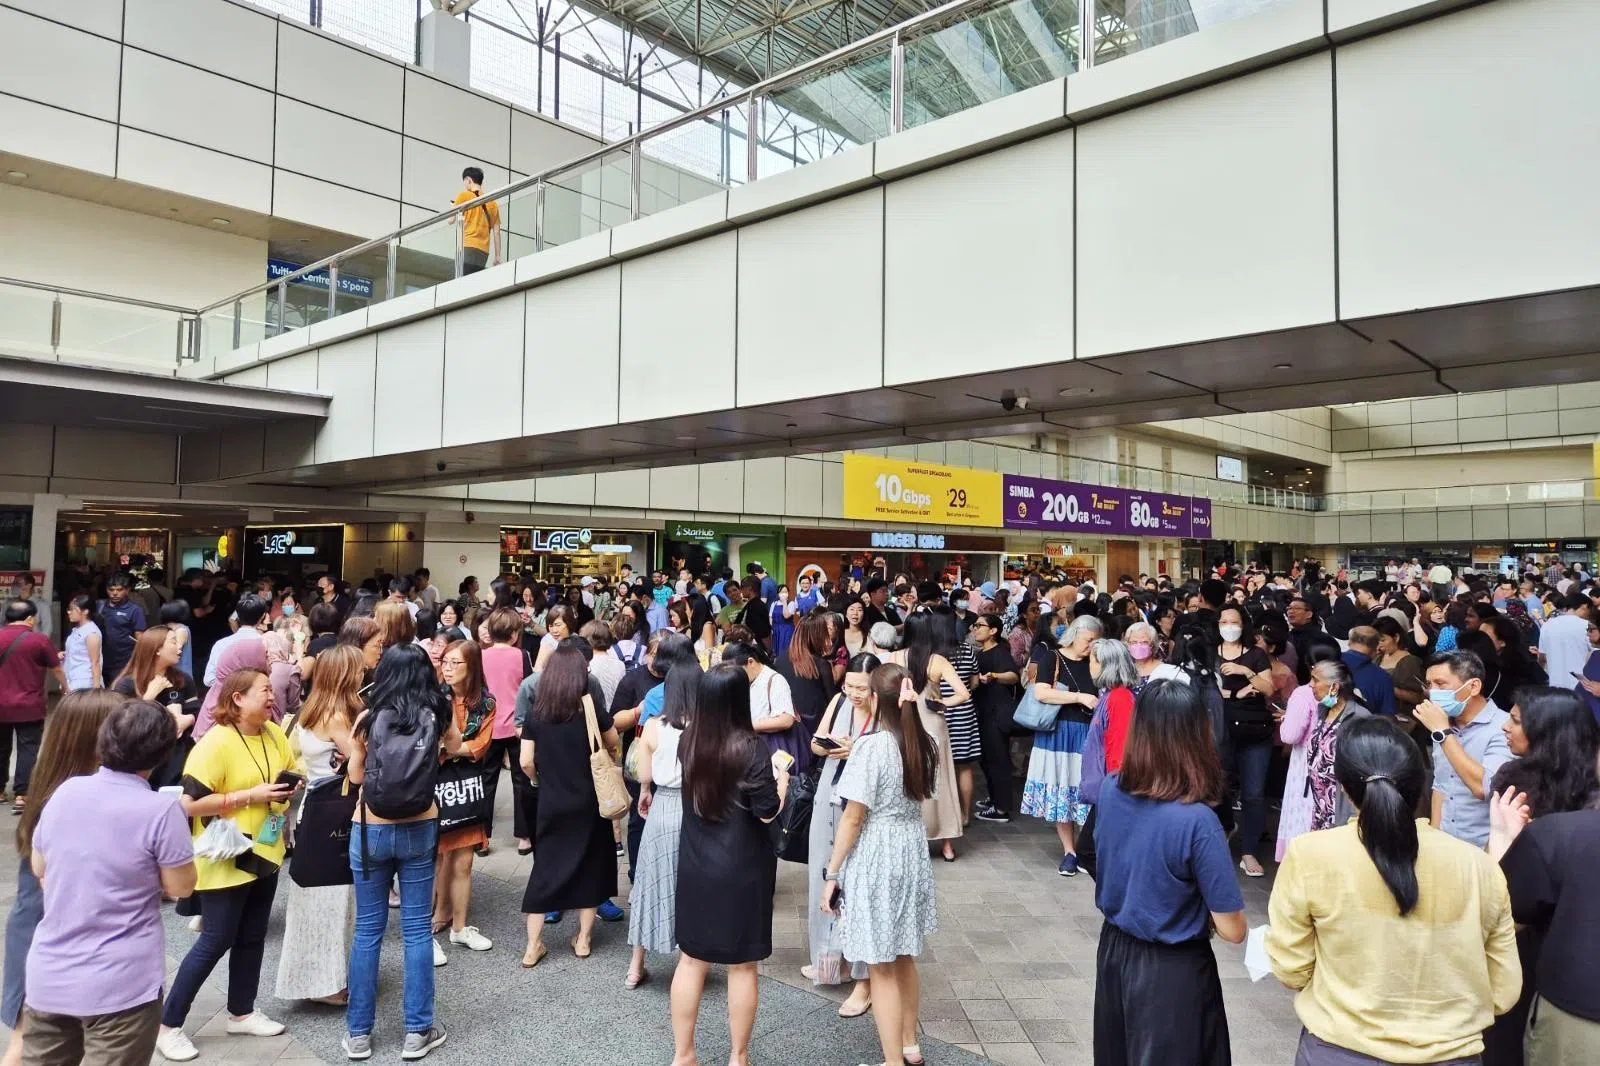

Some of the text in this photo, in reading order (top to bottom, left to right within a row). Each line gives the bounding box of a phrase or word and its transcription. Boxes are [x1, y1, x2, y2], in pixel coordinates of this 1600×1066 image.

[342, 280, 369, 293] S'pore
[1009, 485, 1035, 498] SIMBA
[533, 530, 579, 551] LAC
[682, 528, 715, 536] StarHub
[871, 532, 945, 549] BURGER KING
[262, 534, 287, 554] LAC
[434, 775, 485, 808] YOUTH
